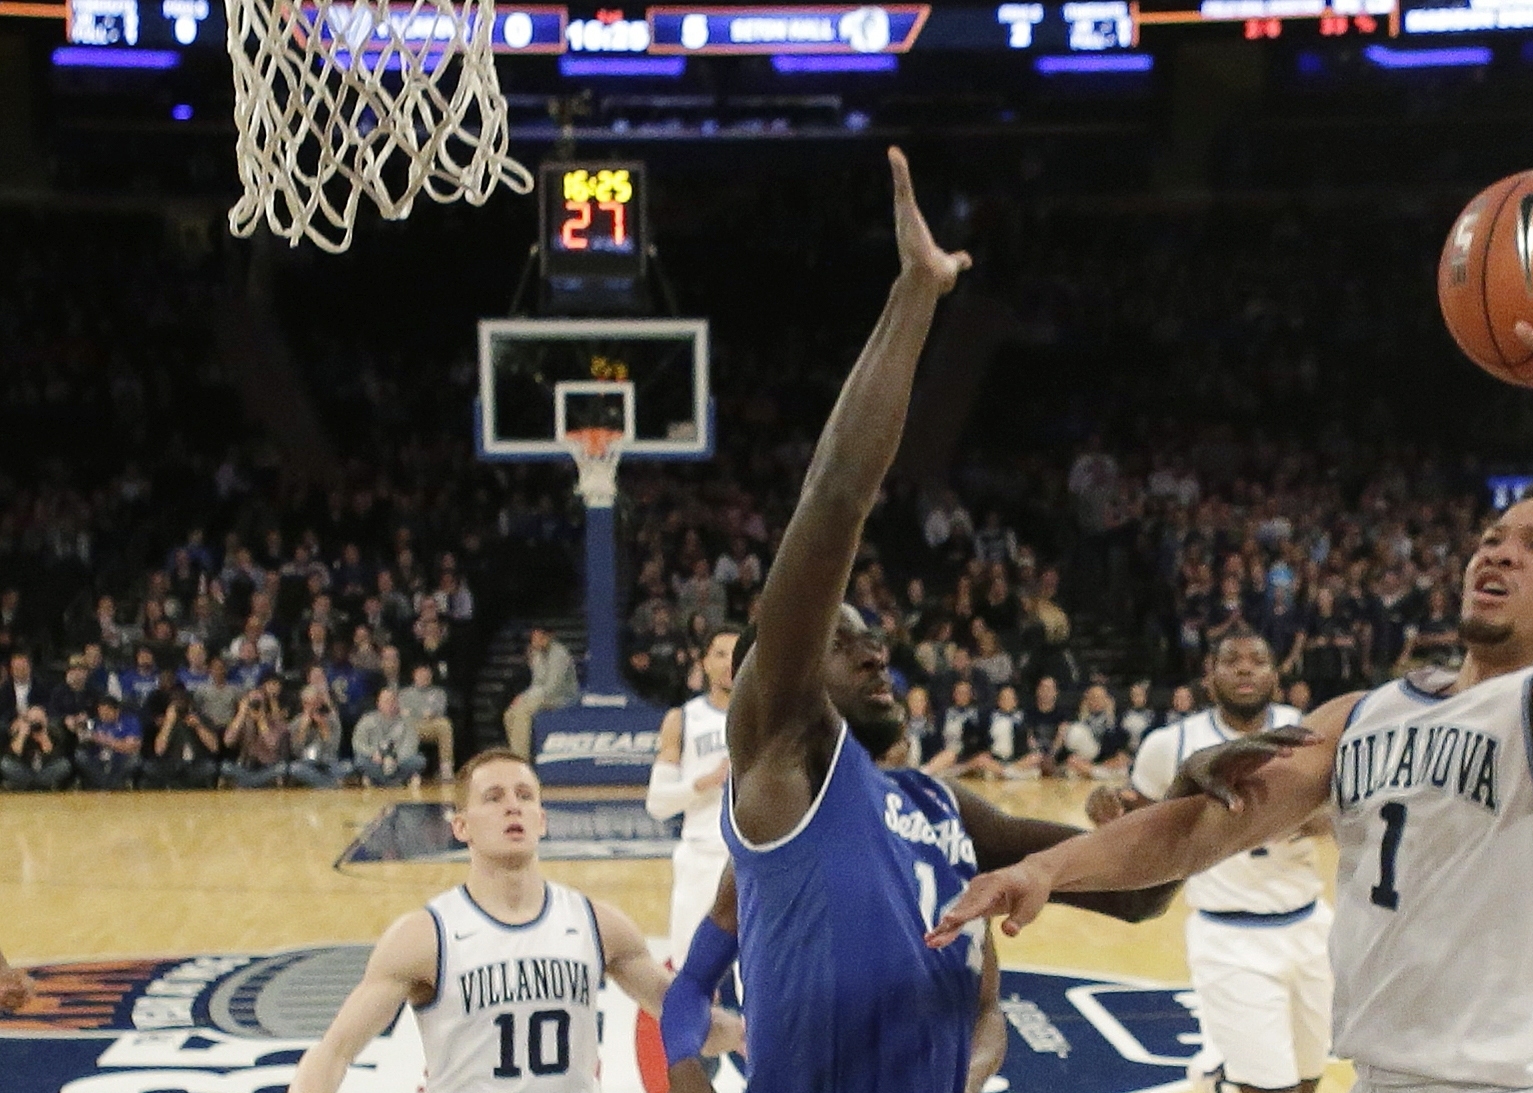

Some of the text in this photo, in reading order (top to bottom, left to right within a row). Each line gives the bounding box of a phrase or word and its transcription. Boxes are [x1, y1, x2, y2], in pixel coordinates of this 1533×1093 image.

[563, 169, 633, 203] 16:25
[561, 200, 627, 249] 27
[1370, 801, 1408, 911] 1
[458, 958, 590, 1014] VILLANOVA
[492, 1009, 571, 1079] 10
